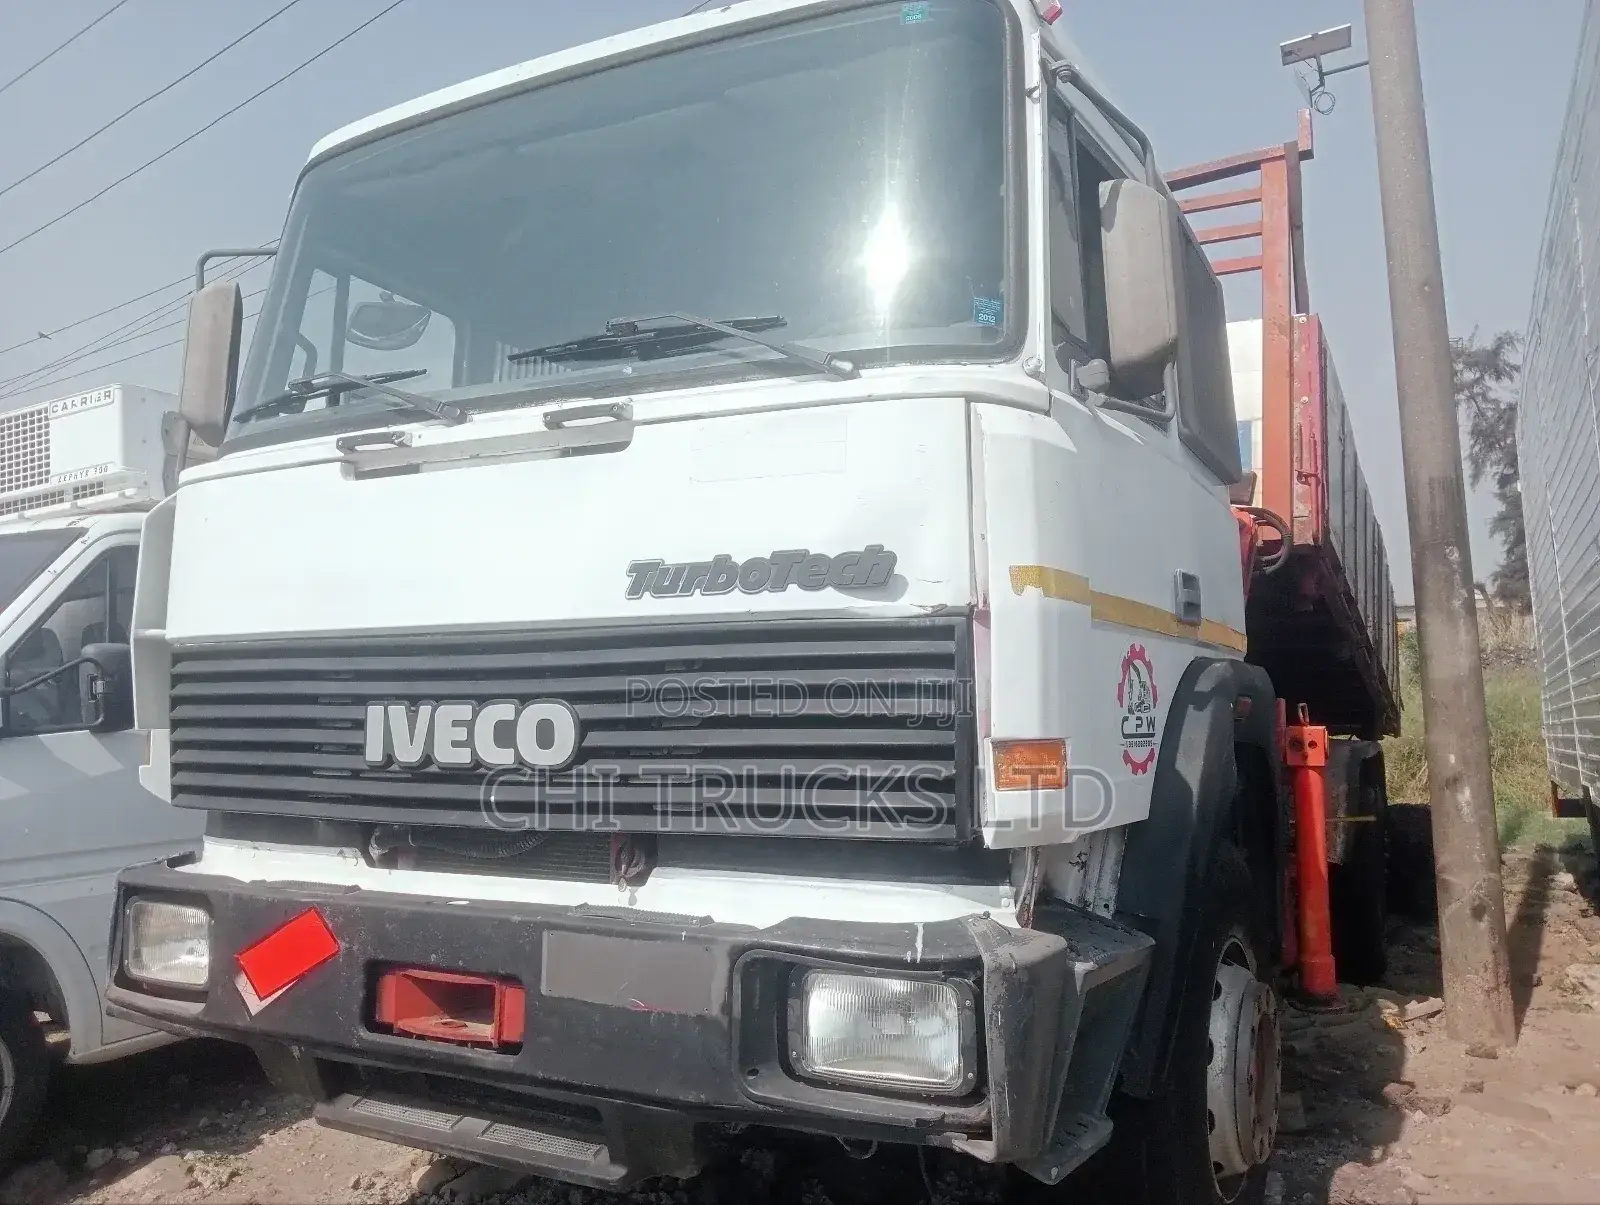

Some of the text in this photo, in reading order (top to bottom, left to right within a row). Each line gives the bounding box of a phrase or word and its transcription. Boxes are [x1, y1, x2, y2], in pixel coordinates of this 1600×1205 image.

[978, 313, 996, 323] 2012
[51, 389, 112, 414] CARRIER
[625, 544, 898, 600] TurboTech
[364, 701, 577, 768] IVECO
